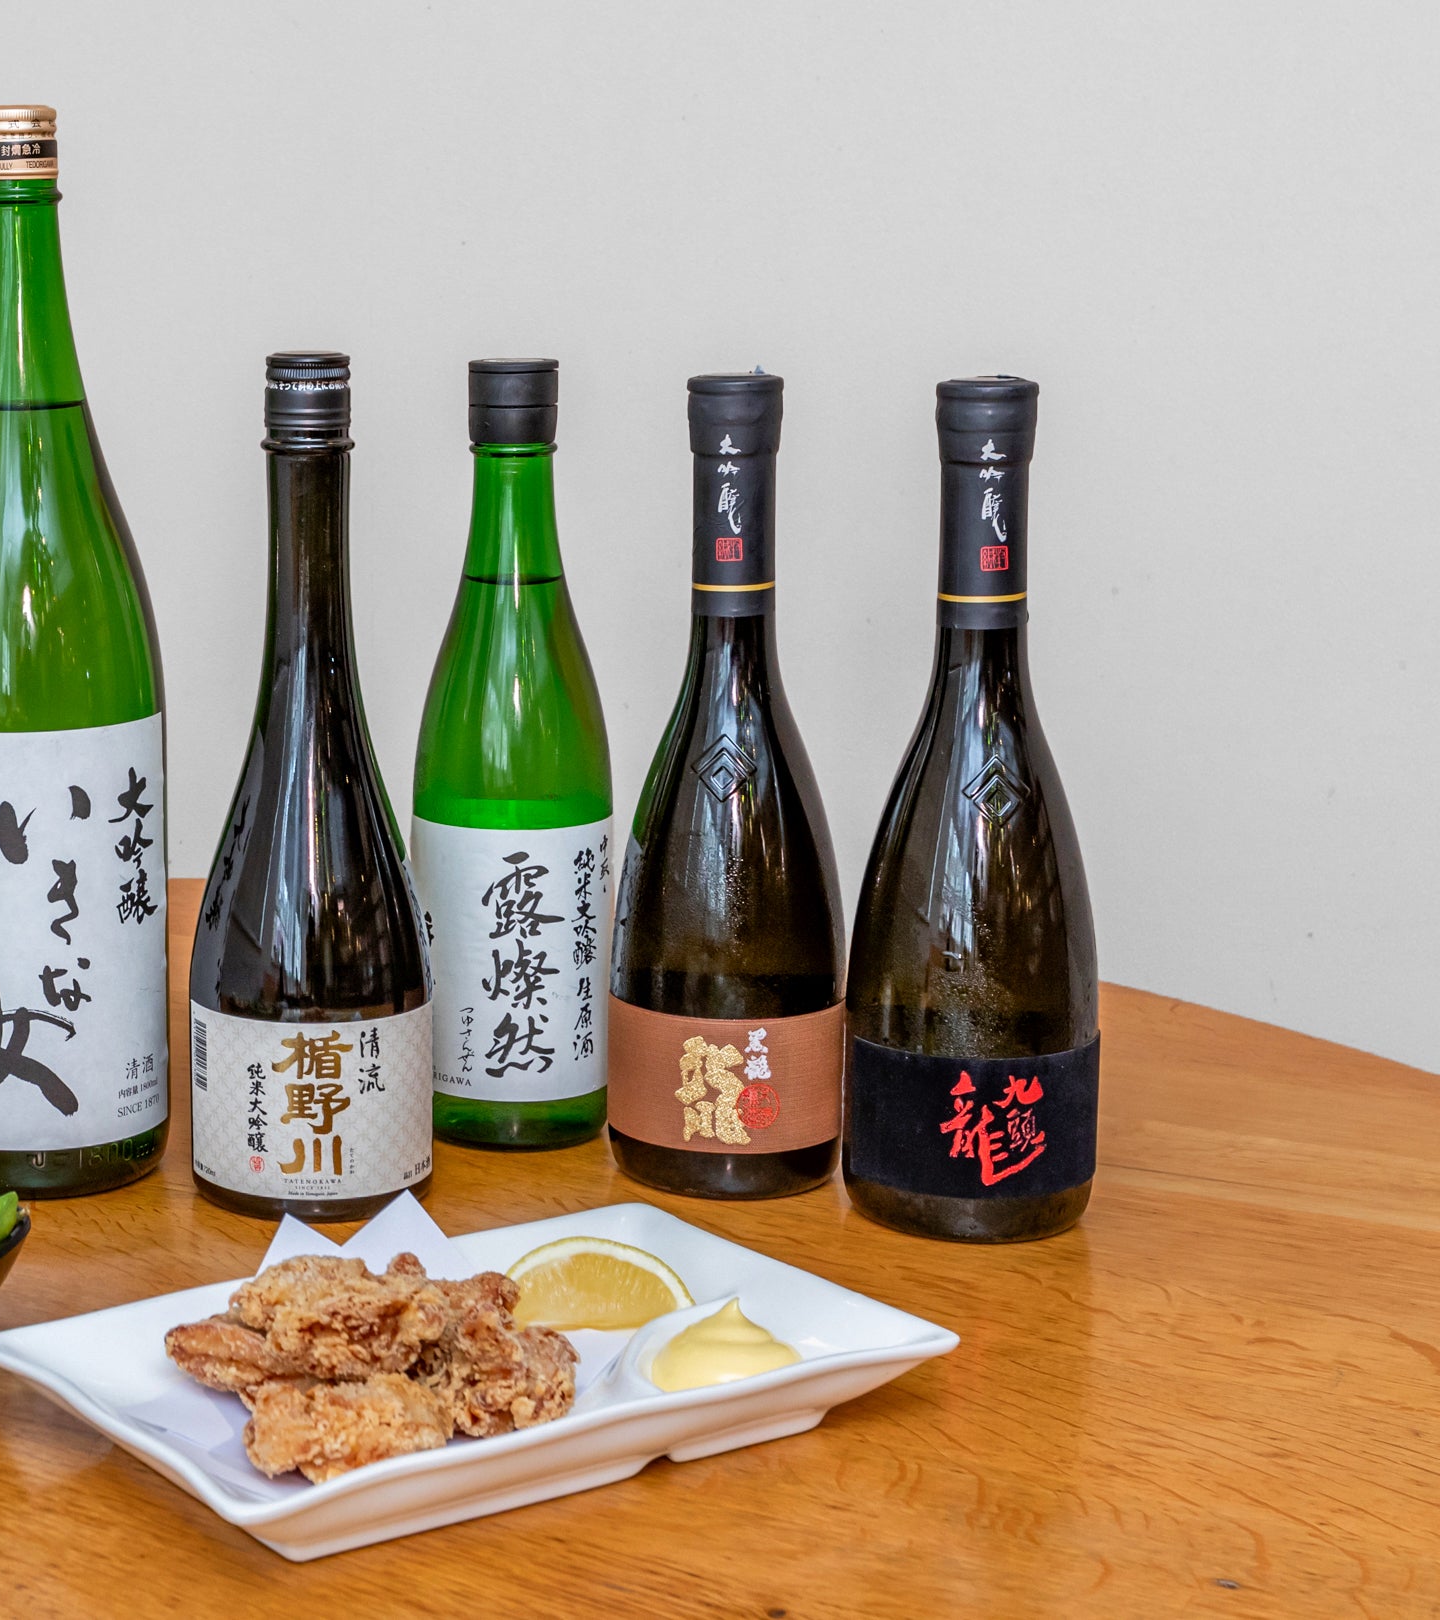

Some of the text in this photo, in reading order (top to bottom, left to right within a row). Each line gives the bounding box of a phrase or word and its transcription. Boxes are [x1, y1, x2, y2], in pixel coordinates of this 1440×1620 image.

[109, 766, 158, 925] 大吟醸
[481, 851, 565, 1079] 露燦然
[117, 1093, 160, 1118] SINCE 1870
[125, 1052, 155, 1080] 清酒
[271, 1030, 353, 1176] 楯野川
[357, 1027, 386, 1094] 清流
[247, 1062, 269, 1153] 純米大吟醸
